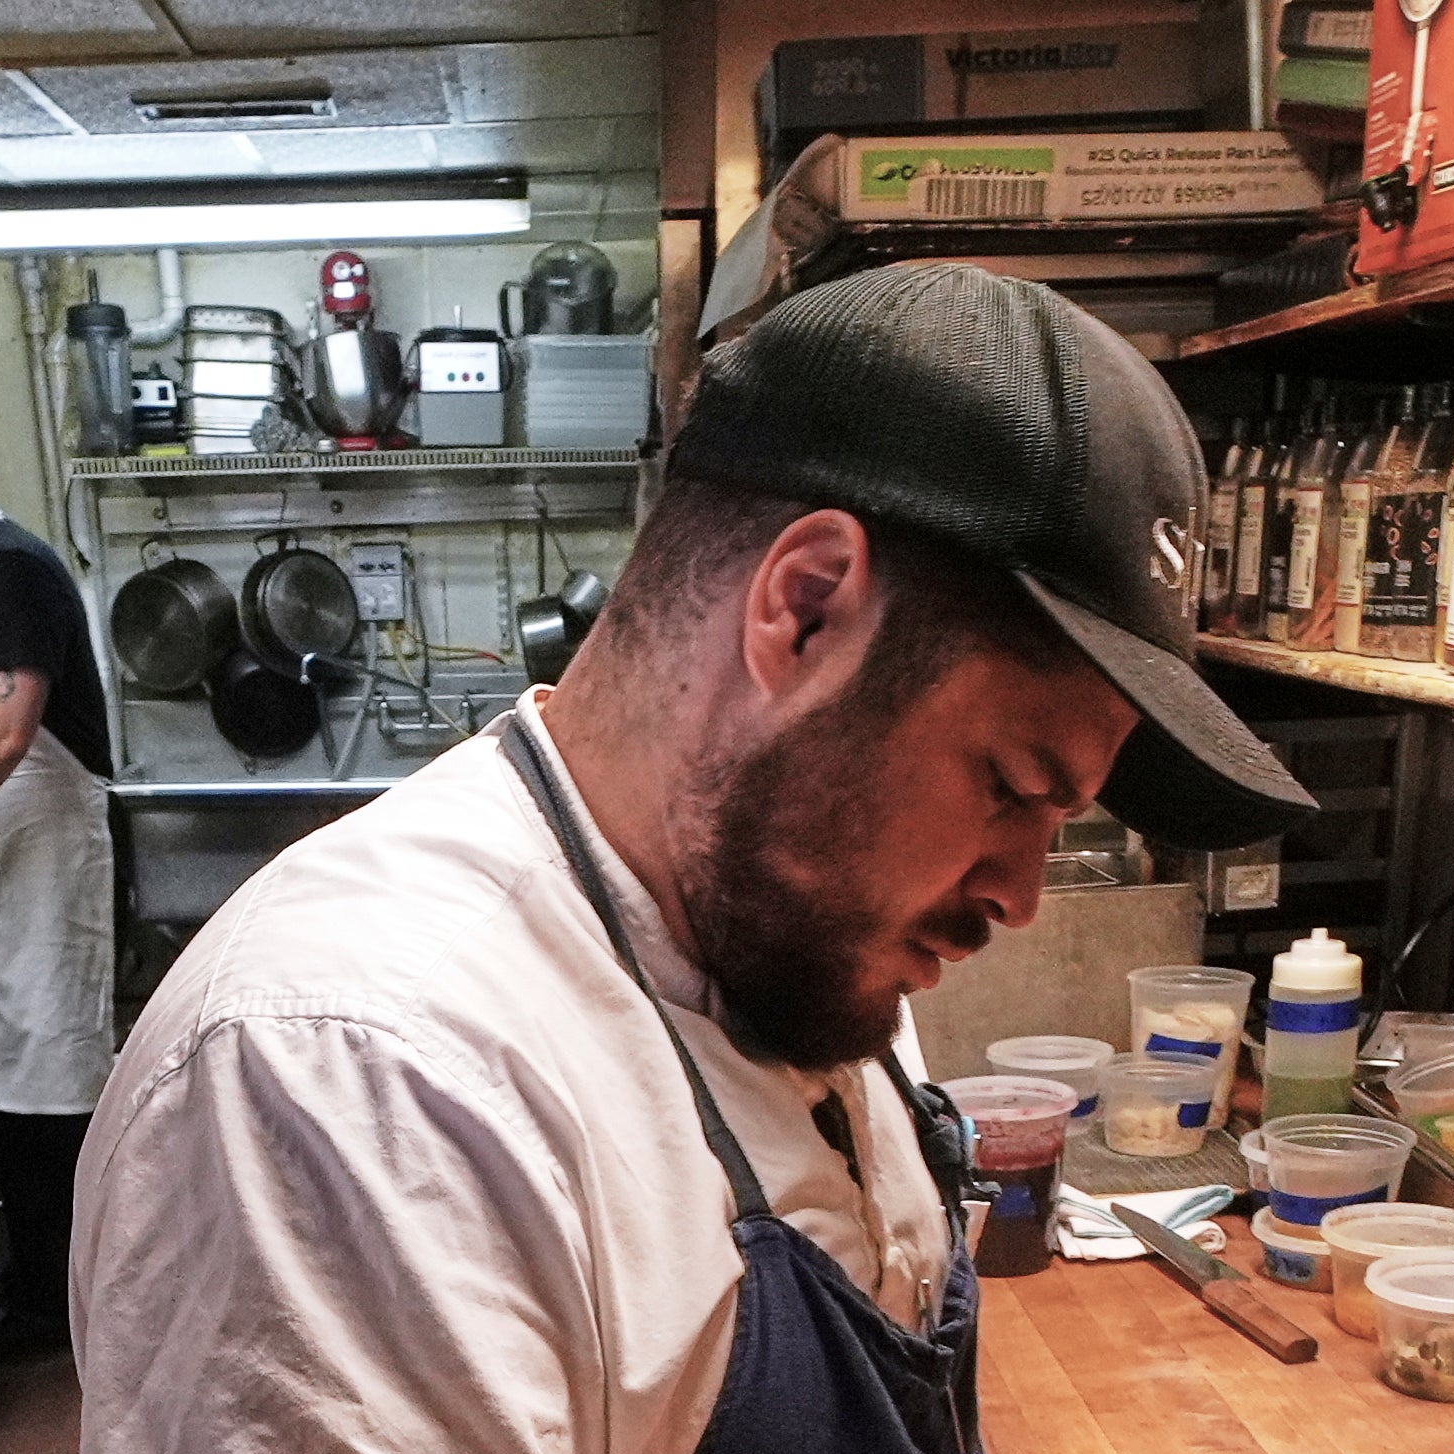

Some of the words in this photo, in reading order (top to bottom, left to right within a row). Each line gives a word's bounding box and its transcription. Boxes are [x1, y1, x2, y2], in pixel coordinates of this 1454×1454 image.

[945, 44, 1061, 68] Victoria
[1118, 147, 1164, 163] Quick
[1166, 147, 1221, 161] Release
